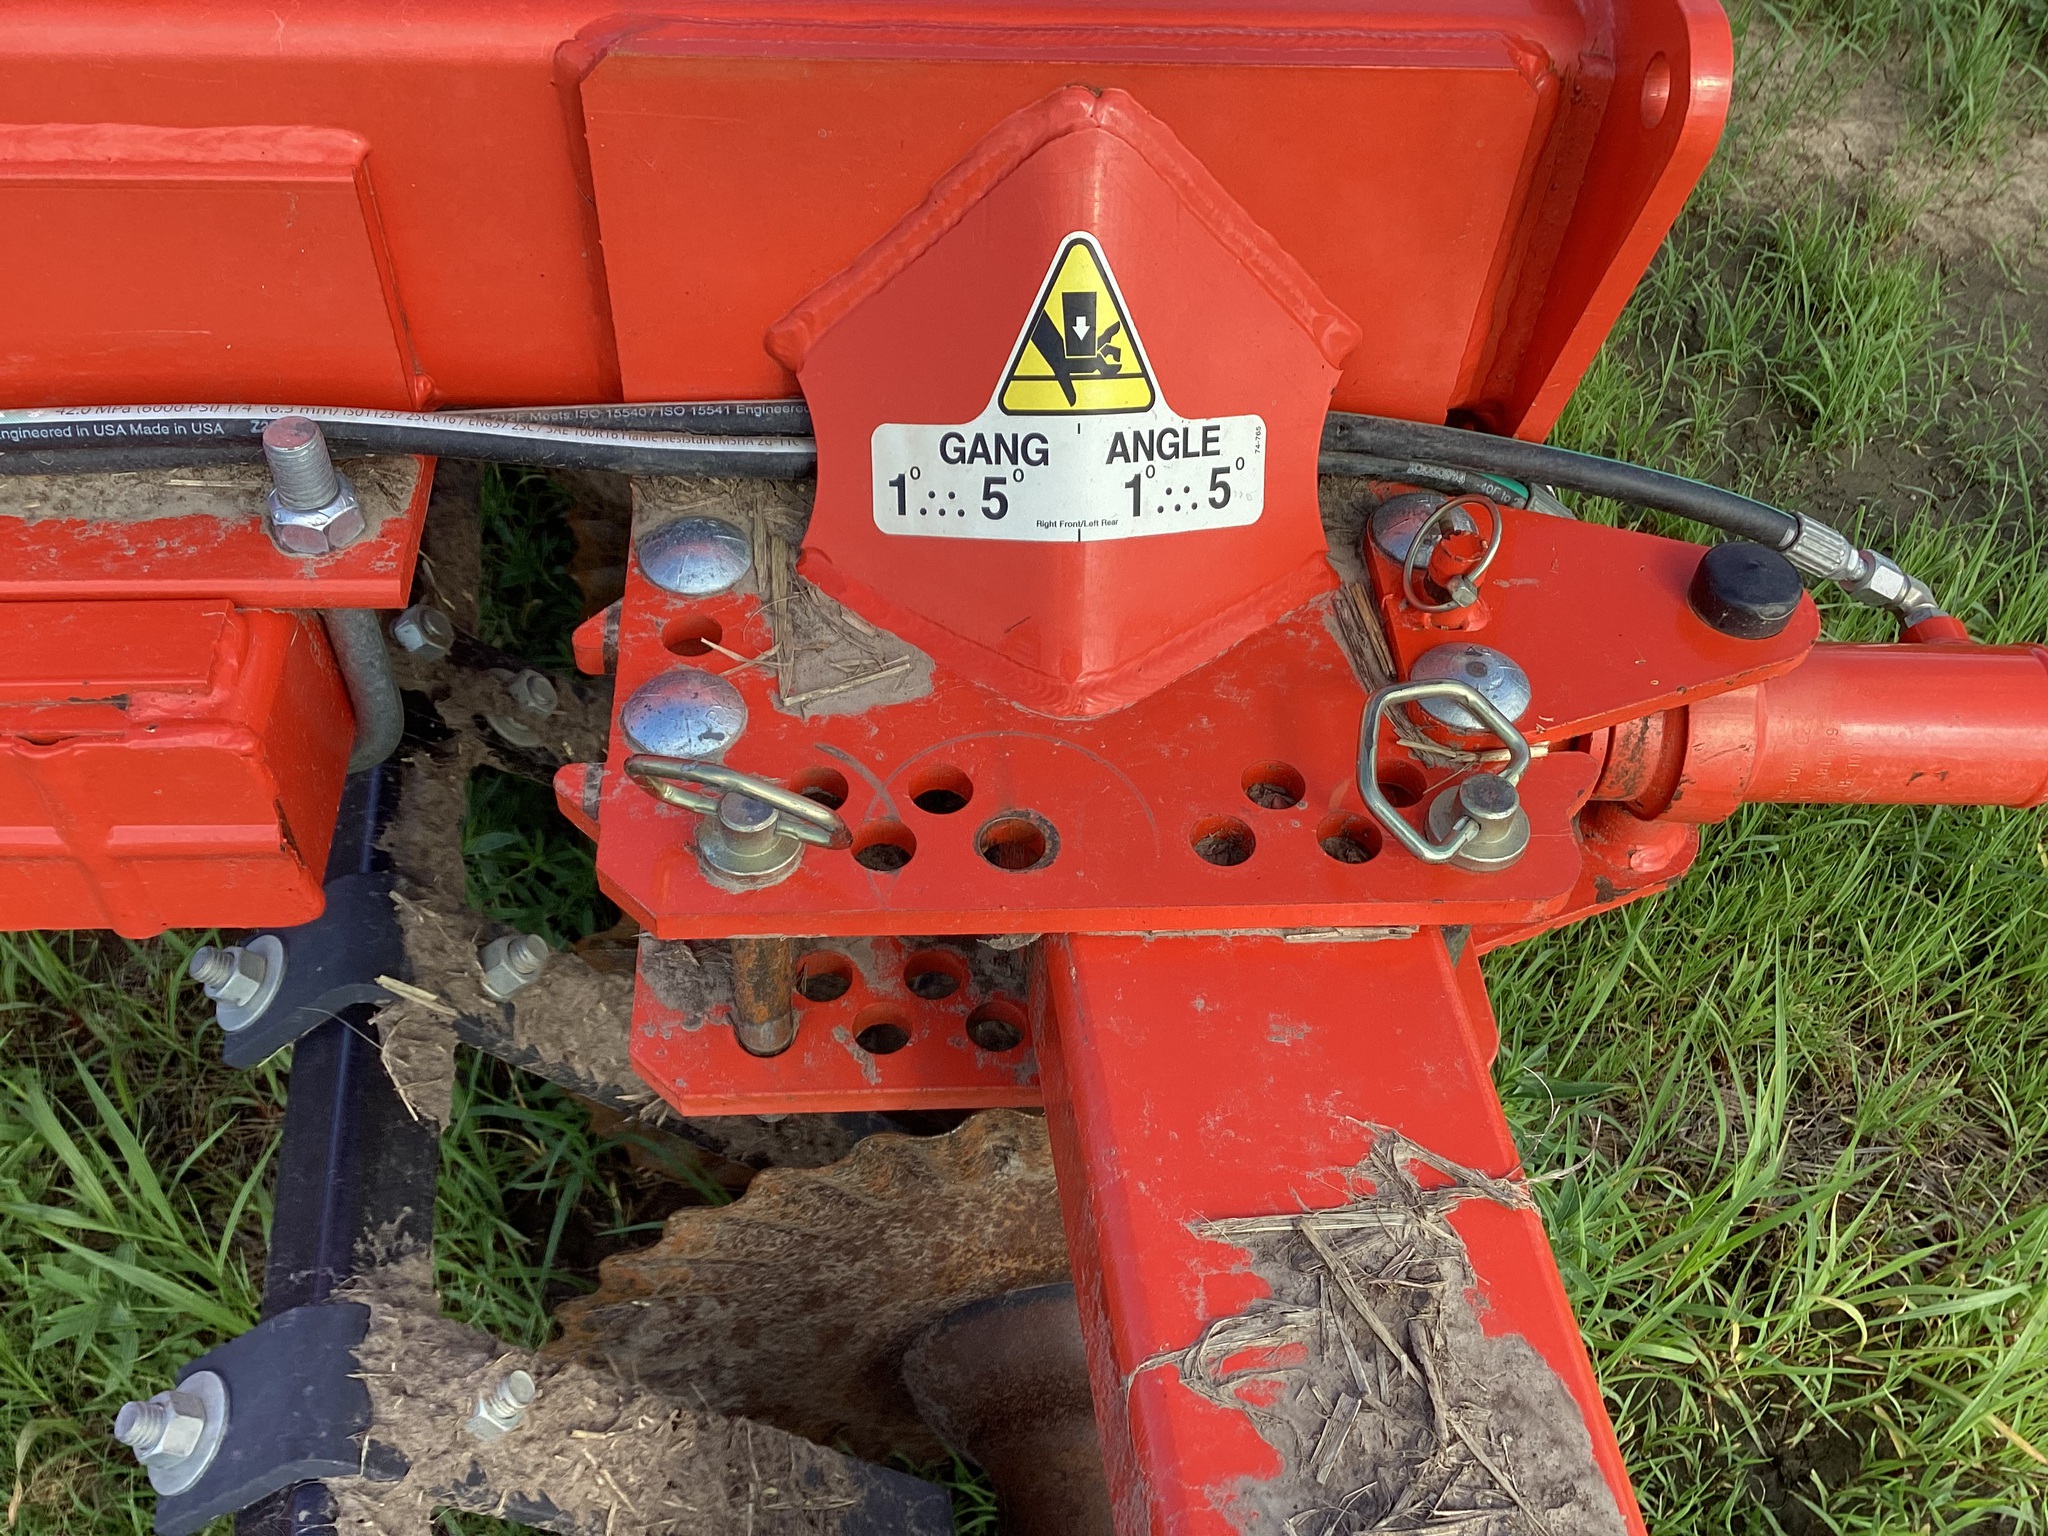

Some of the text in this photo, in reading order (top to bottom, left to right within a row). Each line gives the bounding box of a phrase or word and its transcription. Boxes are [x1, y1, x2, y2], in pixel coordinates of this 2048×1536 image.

[95, 404, 131, 414] MPa
[574, 408, 601, 419] ISO
[660, 405, 686, 417] ISO
[691, 405, 730, 416] 15541
[0, 421, 225, 442] ngineered in USA Made in USA
[939, 424, 1221, 467] GANG ANGLE
[1036, 518, 1119, 529] Right Front/Left Rear
